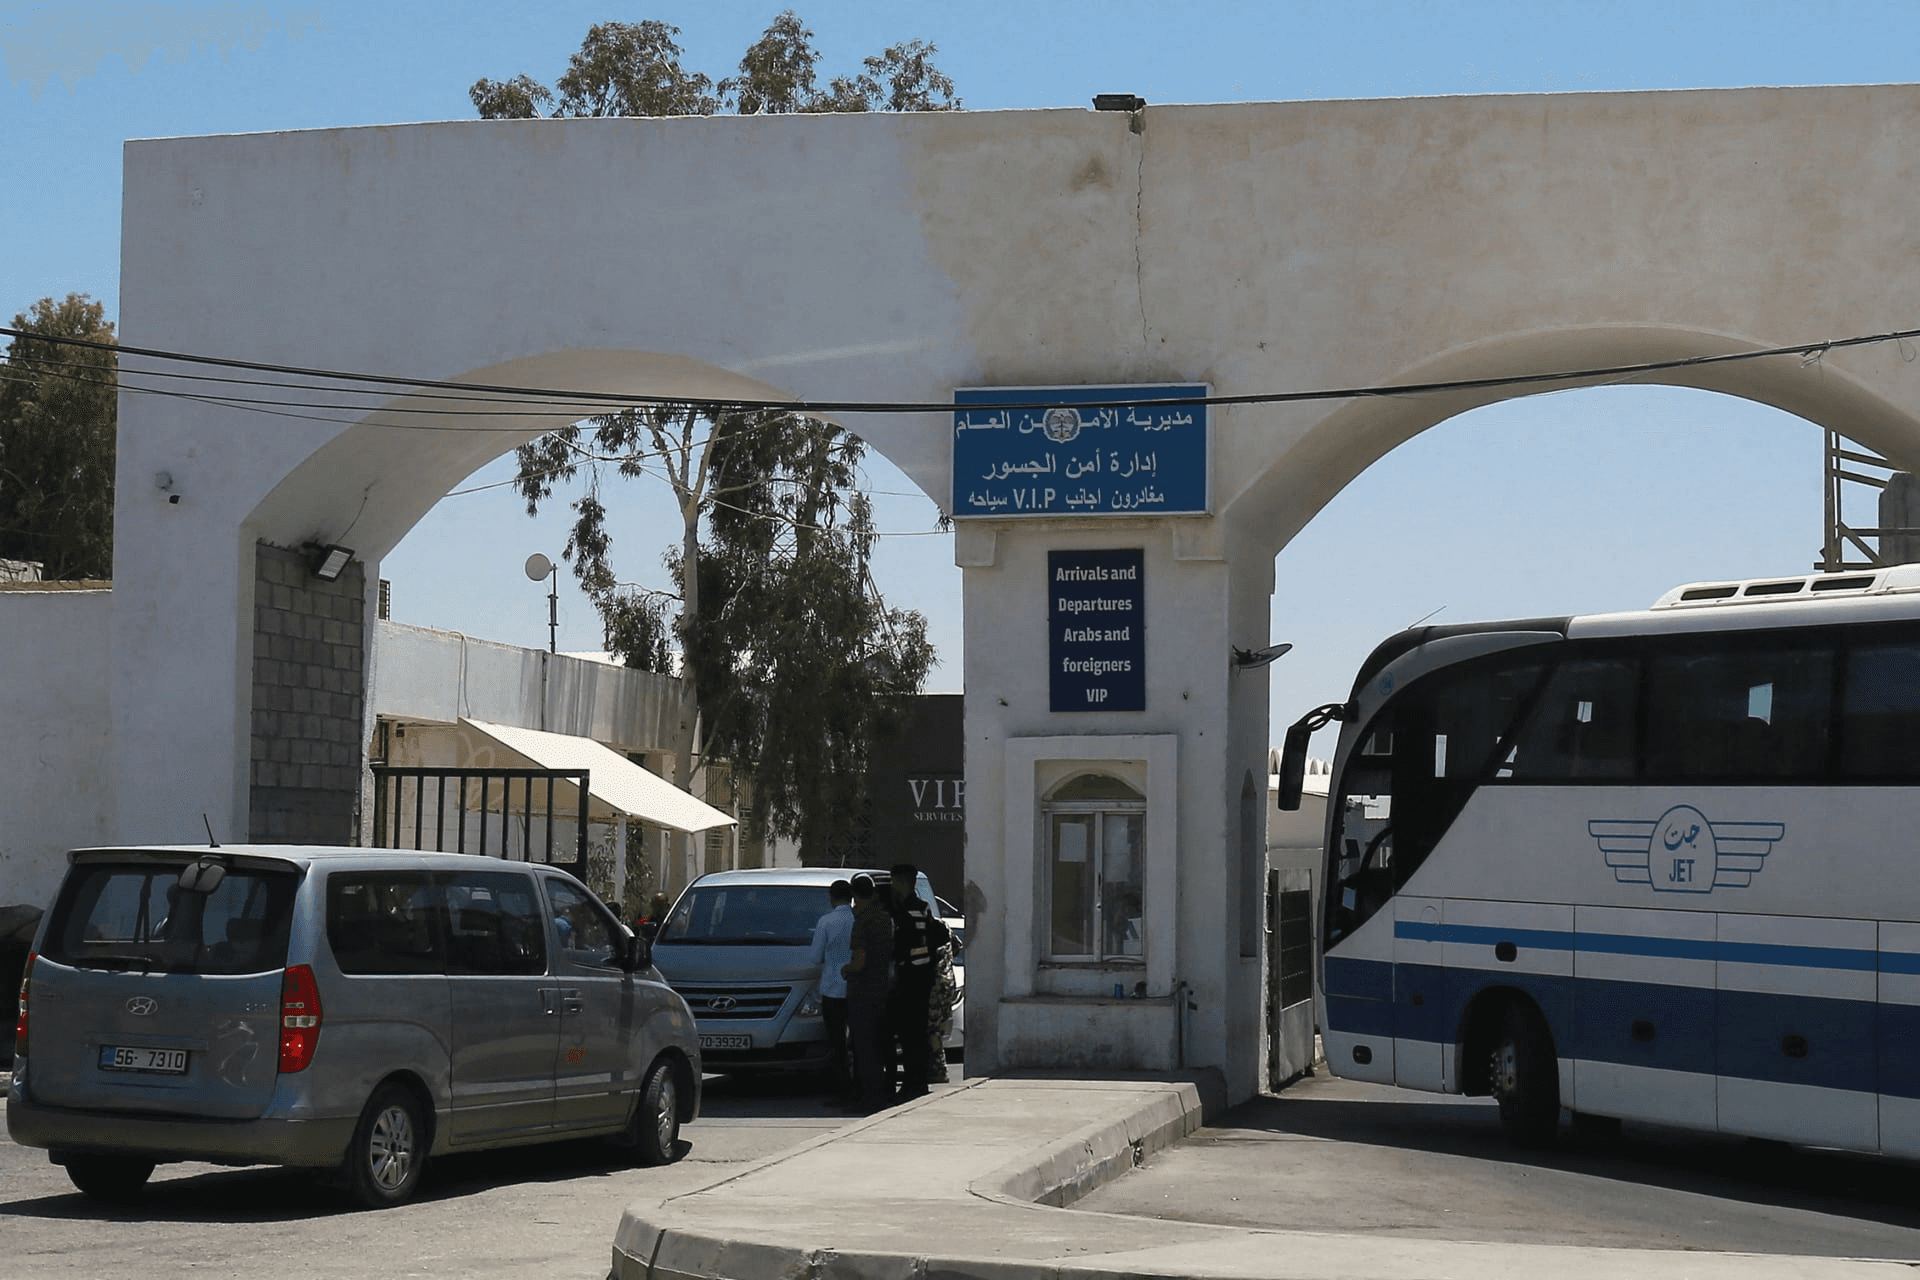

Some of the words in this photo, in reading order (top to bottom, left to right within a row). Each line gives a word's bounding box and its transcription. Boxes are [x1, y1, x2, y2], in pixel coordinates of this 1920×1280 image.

[982, 452, 1056, 480] الجسور
[1066, 448, 1101, 478] أمن
[1110, 451, 1157, 477] إدارة
[1013, 488, 1056, 509] V.I.P
[1112, 485, 1165, 509] مغادرون
[1056, 566, 1108, 581] Arrivals
[1111, 566, 1136, 580] and
[1058, 598, 1132, 615] Departures
[1064, 627, 1102, 642] Arabs
[1104, 627, 1130, 641] and
[1063, 657, 1131, 676] foreigners
[1086, 689, 1108, 702] VIP
[914, 812, 963, 821] SERVICES
[1664, 823, 1700, 851] جت
[1669, 859, 1695, 882] JET
